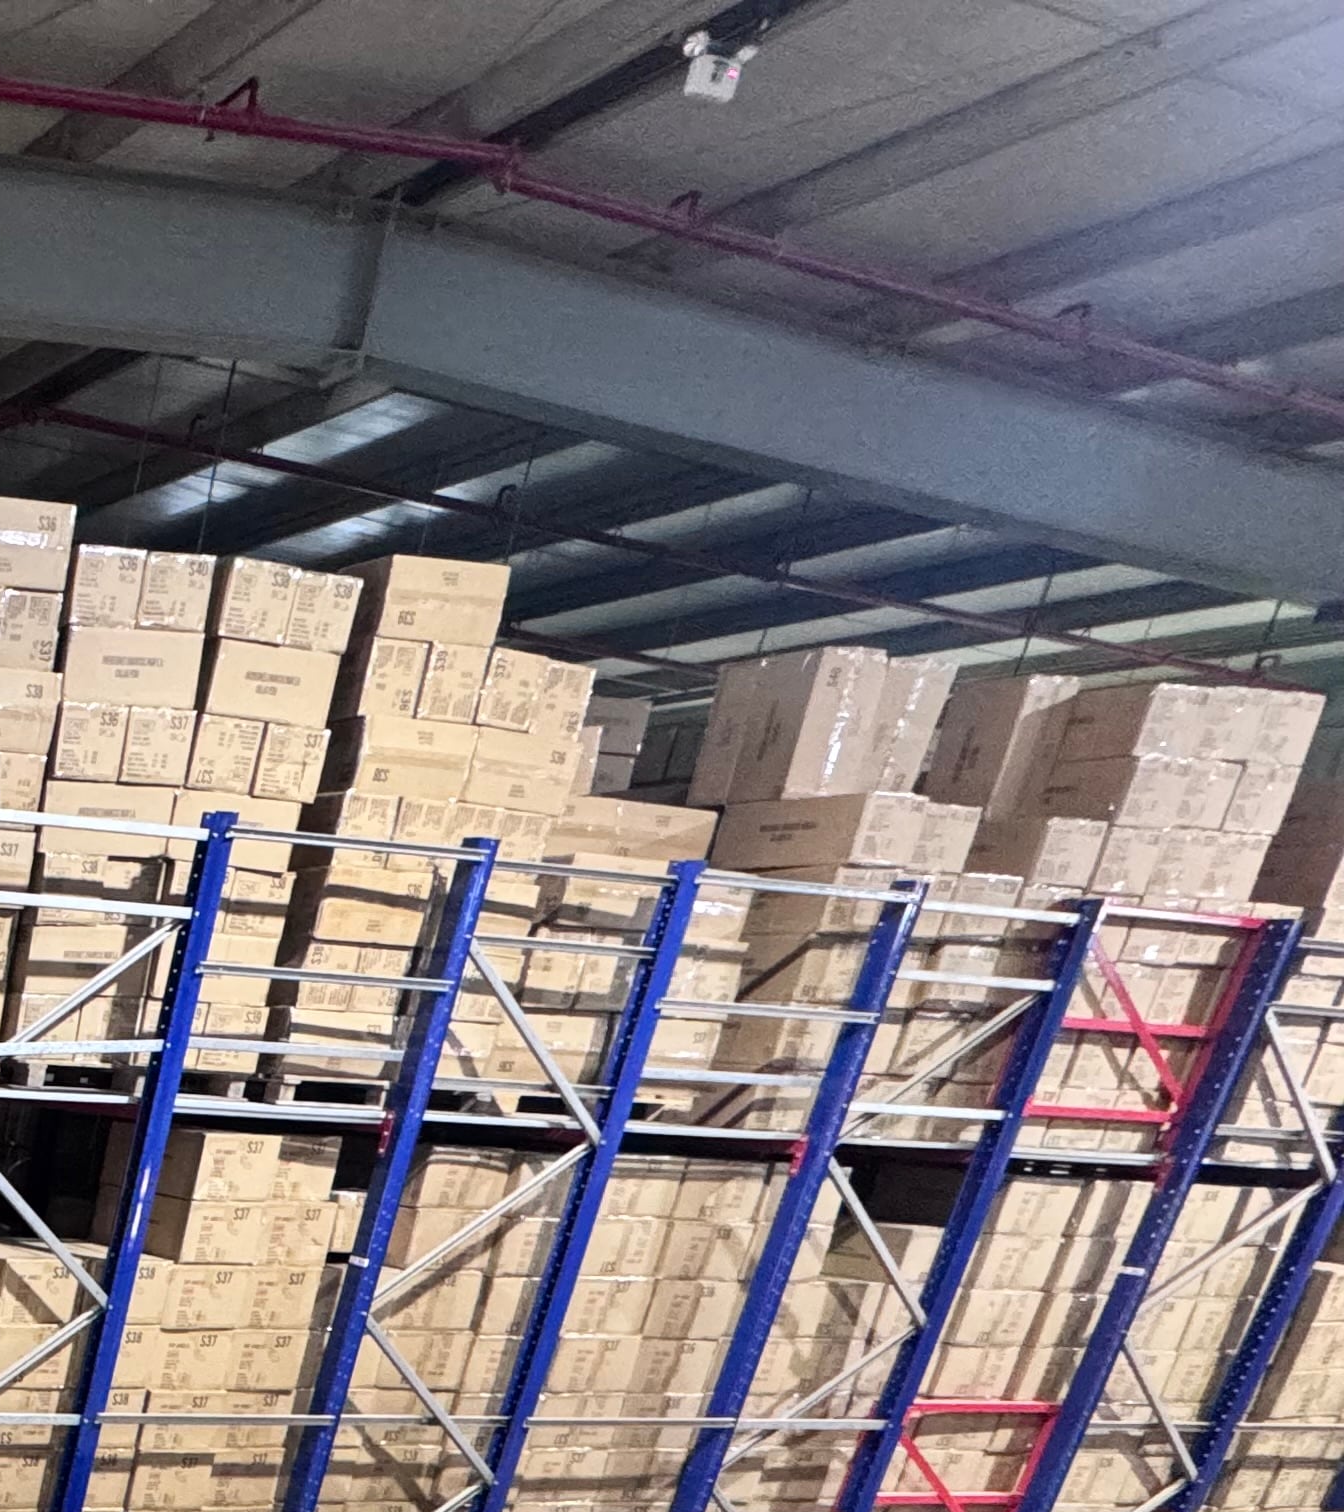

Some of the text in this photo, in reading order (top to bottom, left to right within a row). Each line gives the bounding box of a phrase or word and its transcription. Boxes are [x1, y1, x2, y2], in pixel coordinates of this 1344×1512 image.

[39, 640, 53, 662] S37
[304, 1208, 321, 1221] S37
[216, 1271, 233, 1284] S37
[288, 1272, 306, 1285] S37
[200, 1335, 218, 1347] S37
[275, 1336, 292, 1348] S37
[191, 1396, 208, 1408] S37
